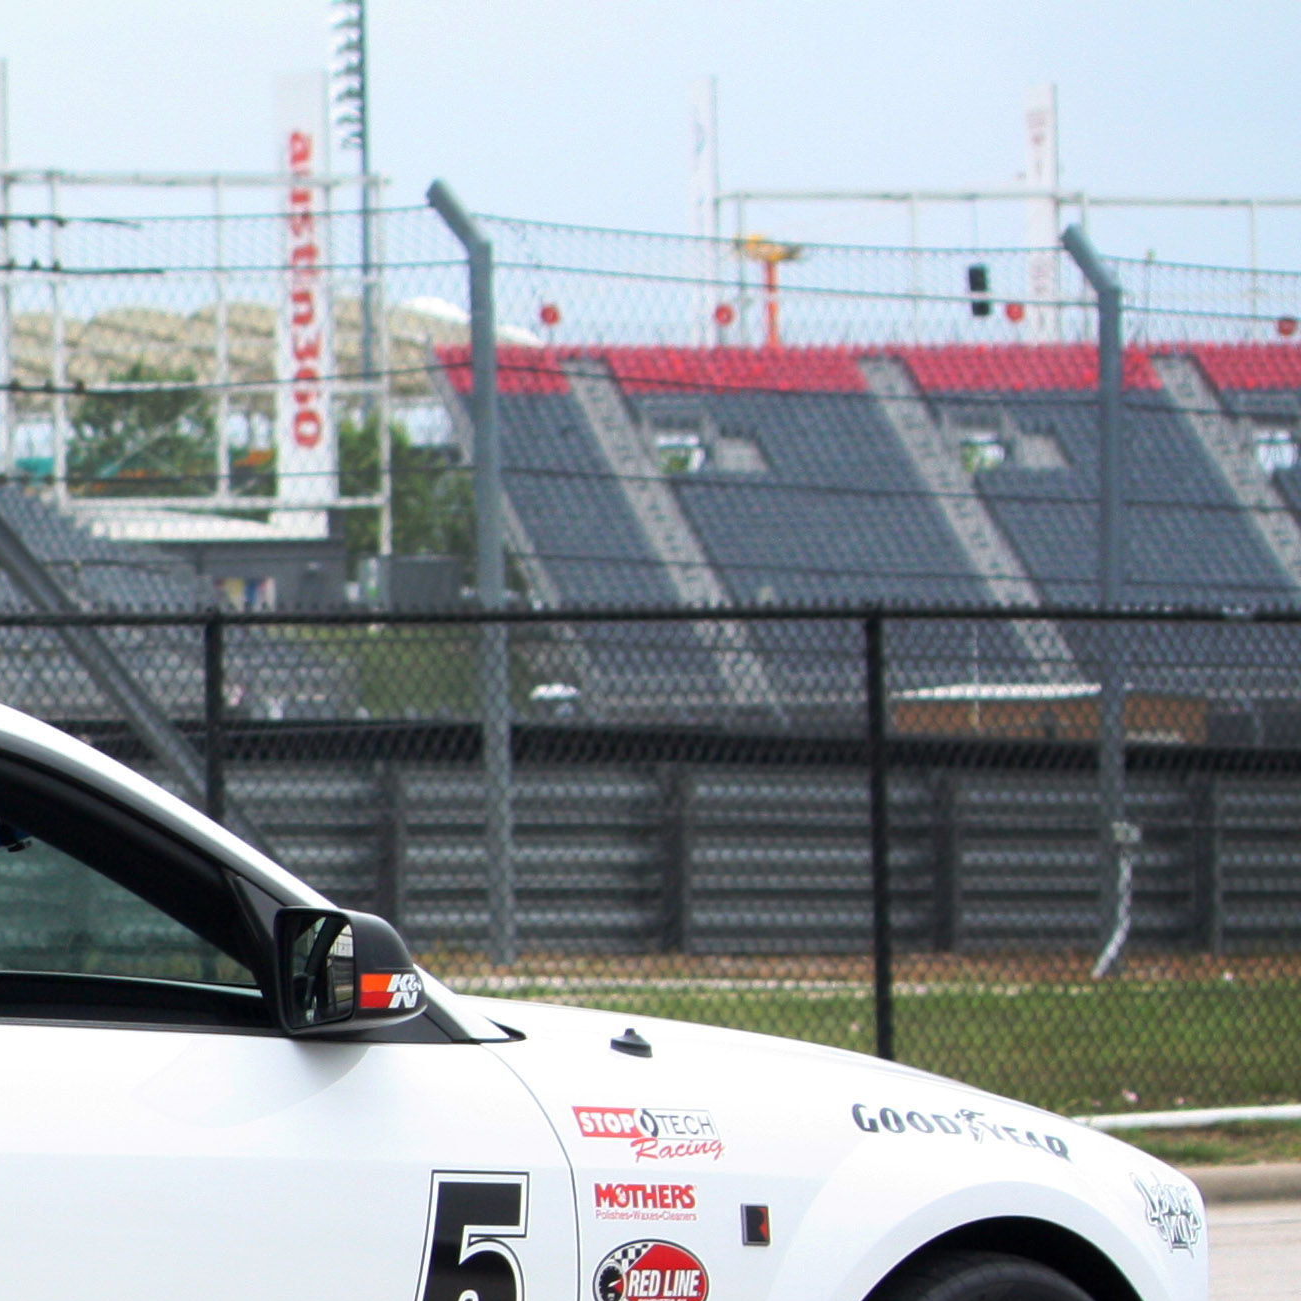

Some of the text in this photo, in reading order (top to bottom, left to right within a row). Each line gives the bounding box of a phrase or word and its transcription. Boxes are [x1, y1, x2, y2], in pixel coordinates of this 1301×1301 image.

[629, 1136, 726, 1164] Racing
[594, 1182, 696, 1210] MOTHERS
[627, 1269, 701, 1298] RED LINE
